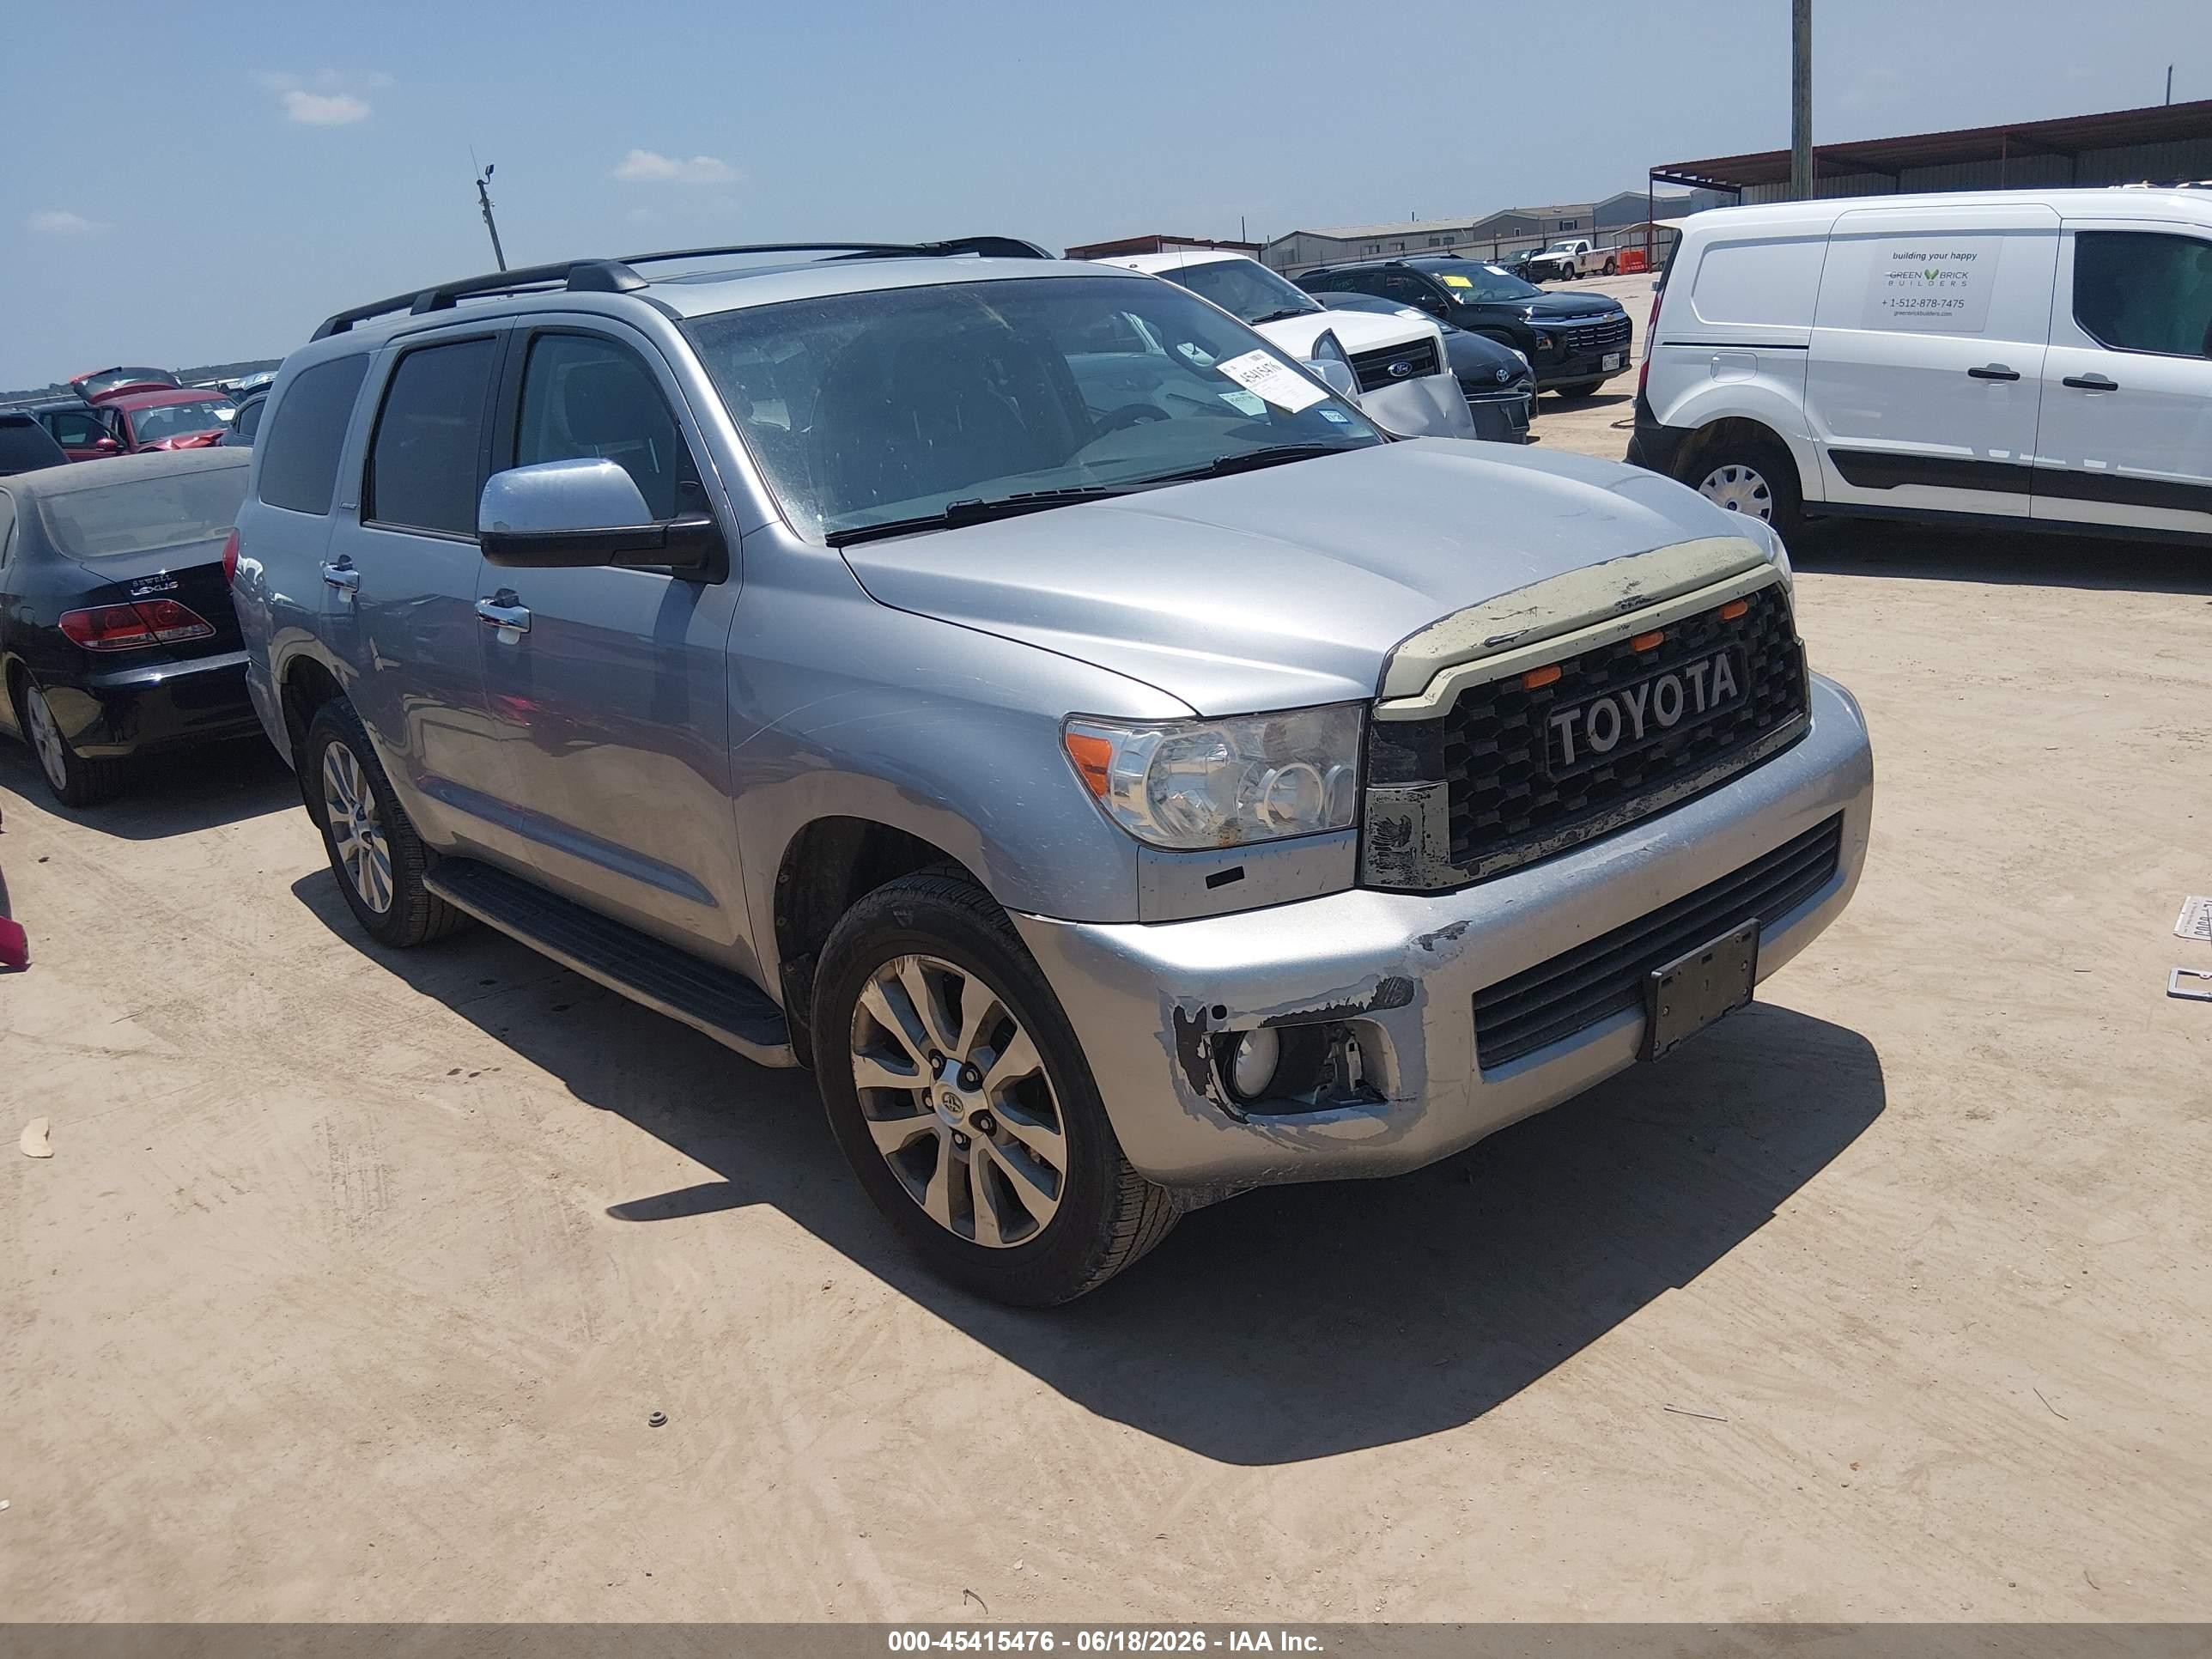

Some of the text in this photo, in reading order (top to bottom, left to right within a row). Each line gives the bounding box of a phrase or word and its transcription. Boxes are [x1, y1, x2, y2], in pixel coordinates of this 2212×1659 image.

[1893, 252, 1927, 261] building
[1950, 252, 1978, 261] happy
[1889, 298, 1966, 308] 1-512-878-7475
[1239, 362, 1282, 384] 45415476
[133, 574, 173, 586] SEWELL
[131, 581, 179, 596] LEXUS
[1550, 652, 1738, 766] TOYOTA
